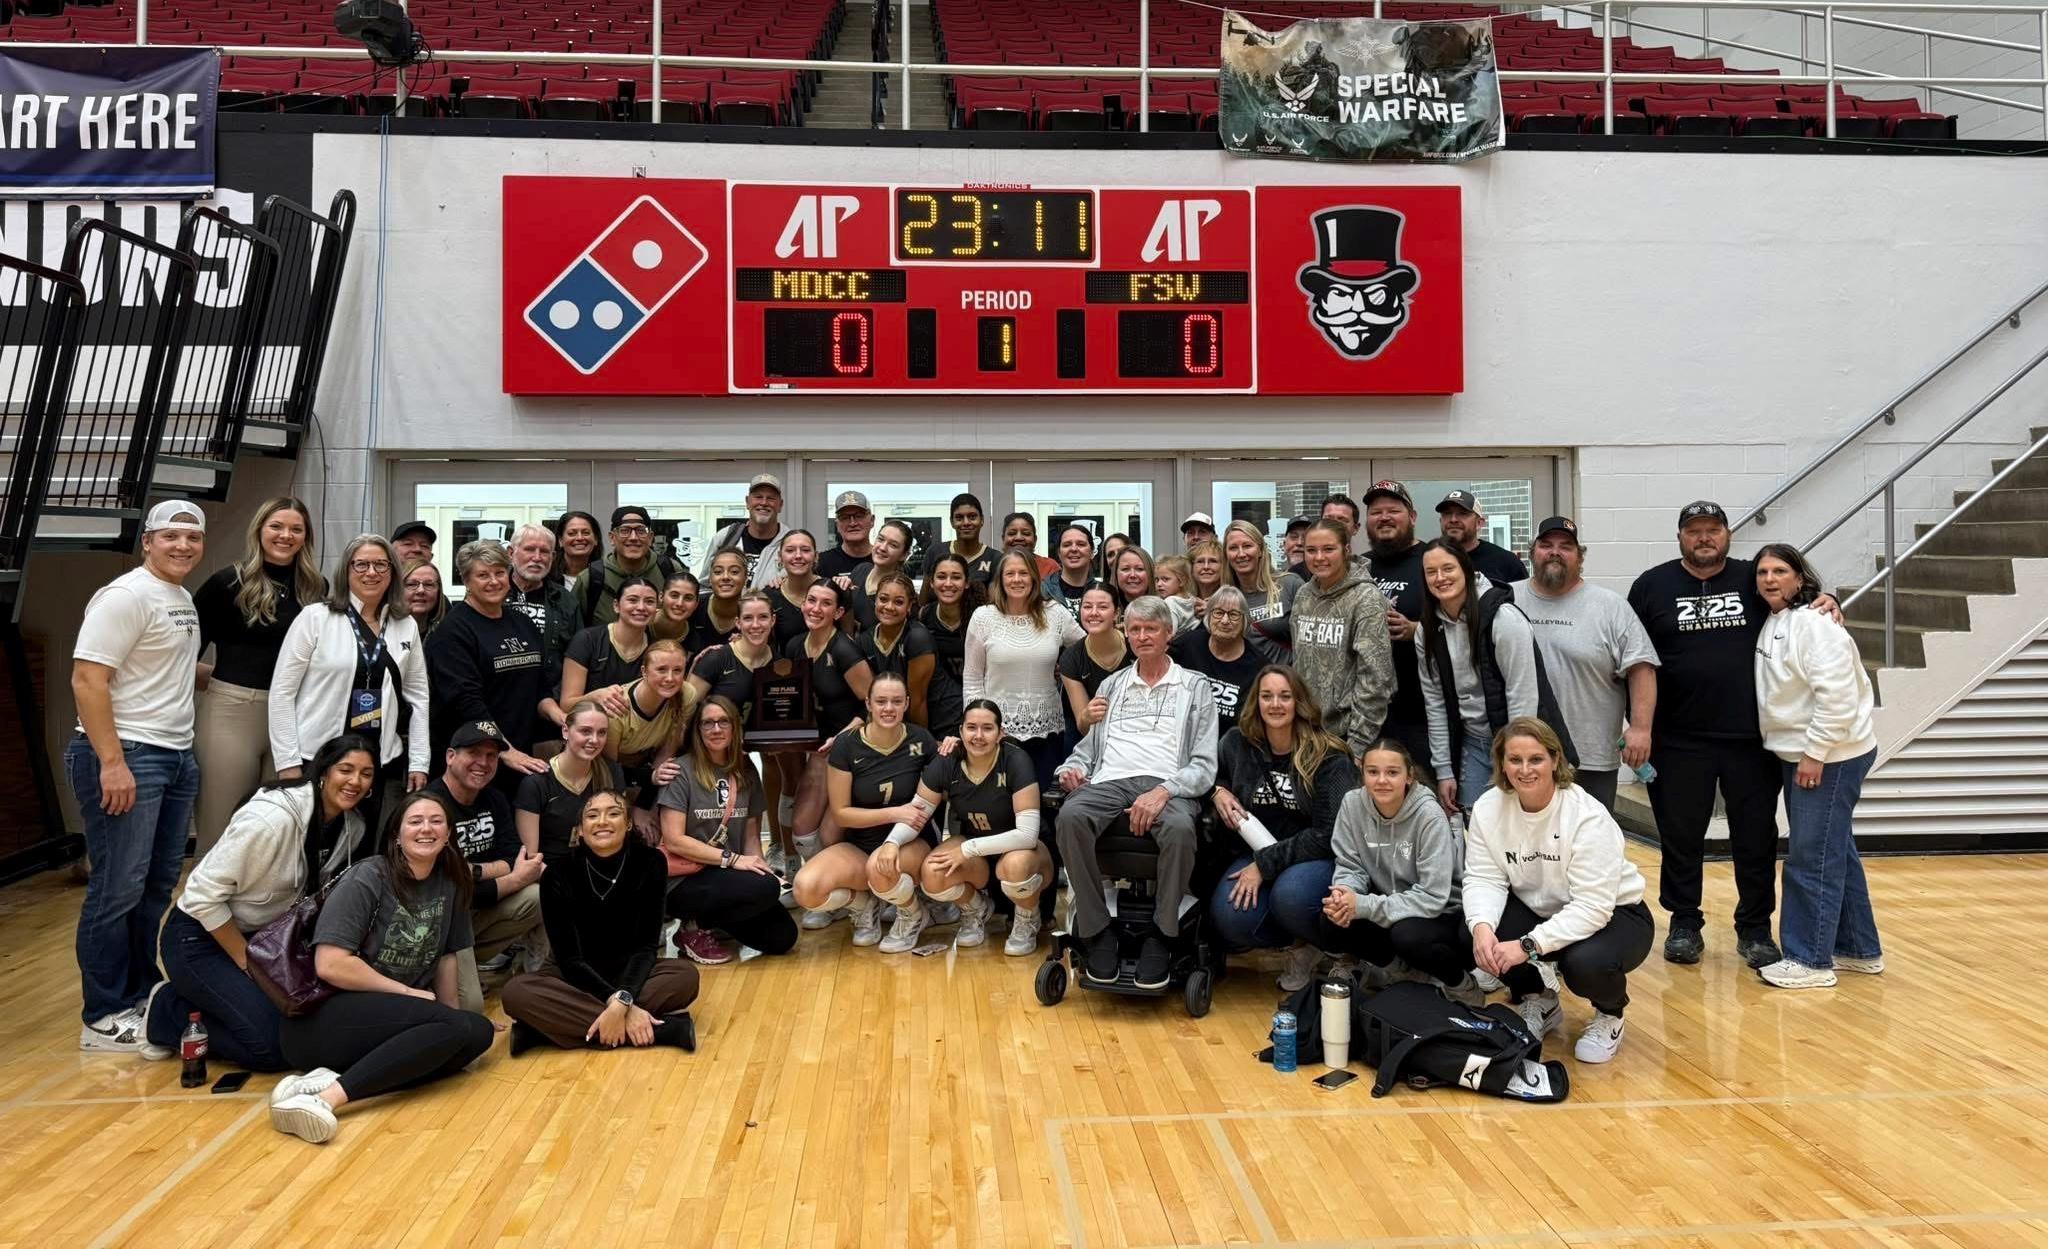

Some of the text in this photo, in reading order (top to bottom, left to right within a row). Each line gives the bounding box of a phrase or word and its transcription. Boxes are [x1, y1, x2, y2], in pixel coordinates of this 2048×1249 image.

[1337, 71, 1447, 99] SPECIAL
[0, 93, 198, 150] RT HERE
[1280, 112, 1297, 120] AIR
[1298, 113, 1330, 123] FORCE
[1337, 97, 1468, 124] WARFARE
[774, 194, 861, 259] AP
[1140, 199, 1222, 263] AP
[773, 270, 870, 299] MDCC
[1129, 273, 1200, 301] FSW
[961, 289, 1033, 310] PERIOD
[833, 312, 868, 374] 0
[1002, 322, 1011, 364] 1
[1183, 313, 1218, 374] 0
[978, 560, 992, 572] N
[1317, 622, 1345, 645] BAR
[1678, 618, 1747, 631] CHAMPIONS
[503, 637, 525, 653] N
[909, 741, 924, 757] N
[996, 771, 1007, 787] N
[879, 781, 894, 805] 7
[967, 811, 992, 831] 18
[1504, 850, 1519, 865] N
